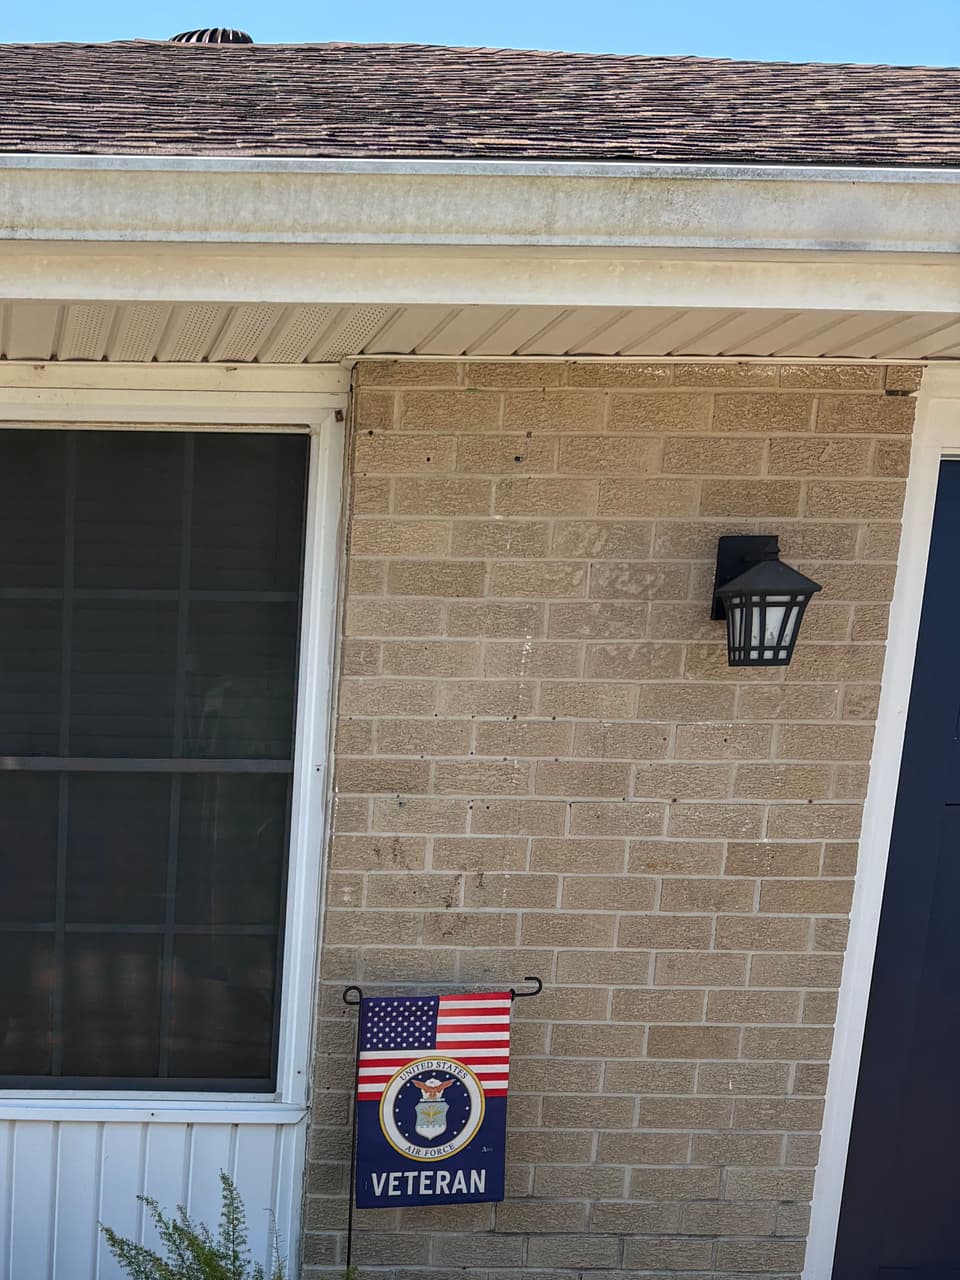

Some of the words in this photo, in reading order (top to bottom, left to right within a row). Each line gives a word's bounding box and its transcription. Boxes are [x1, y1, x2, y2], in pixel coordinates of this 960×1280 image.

[399, 1061, 434, 1081] UNITED
[435, 1061, 468, 1080] STATES
[405, 1144, 421, 1156] AIR
[424, 1143, 456, 1157] FORCE
[371, 1169, 486, 1196] VETERAN
